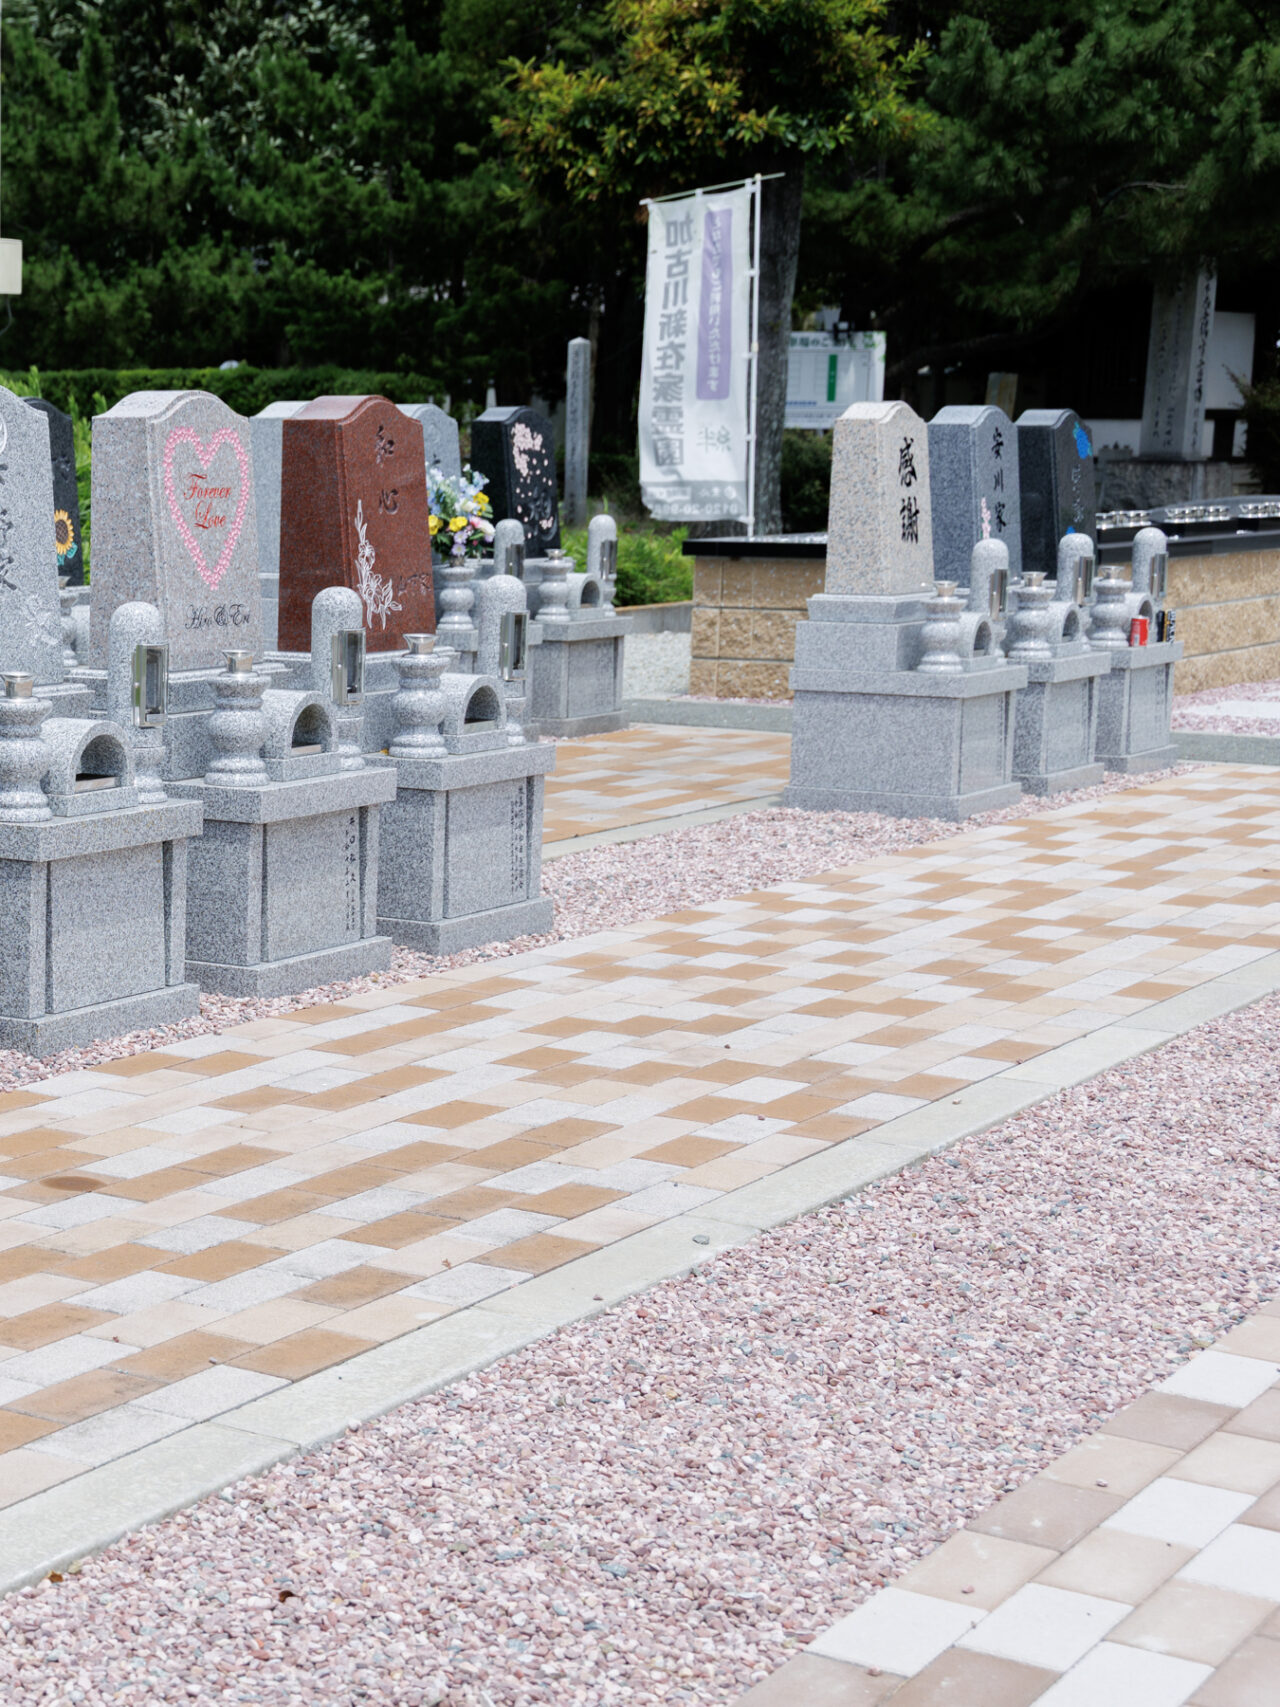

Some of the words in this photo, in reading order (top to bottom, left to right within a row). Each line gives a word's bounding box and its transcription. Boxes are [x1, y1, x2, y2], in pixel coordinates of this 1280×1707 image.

[183, 472, 232, 501] Forever
[899, 436, 920, 544] 感謝
[991, 426, 1007, 533] 安川家
[194, 500, 227, 529] Love
